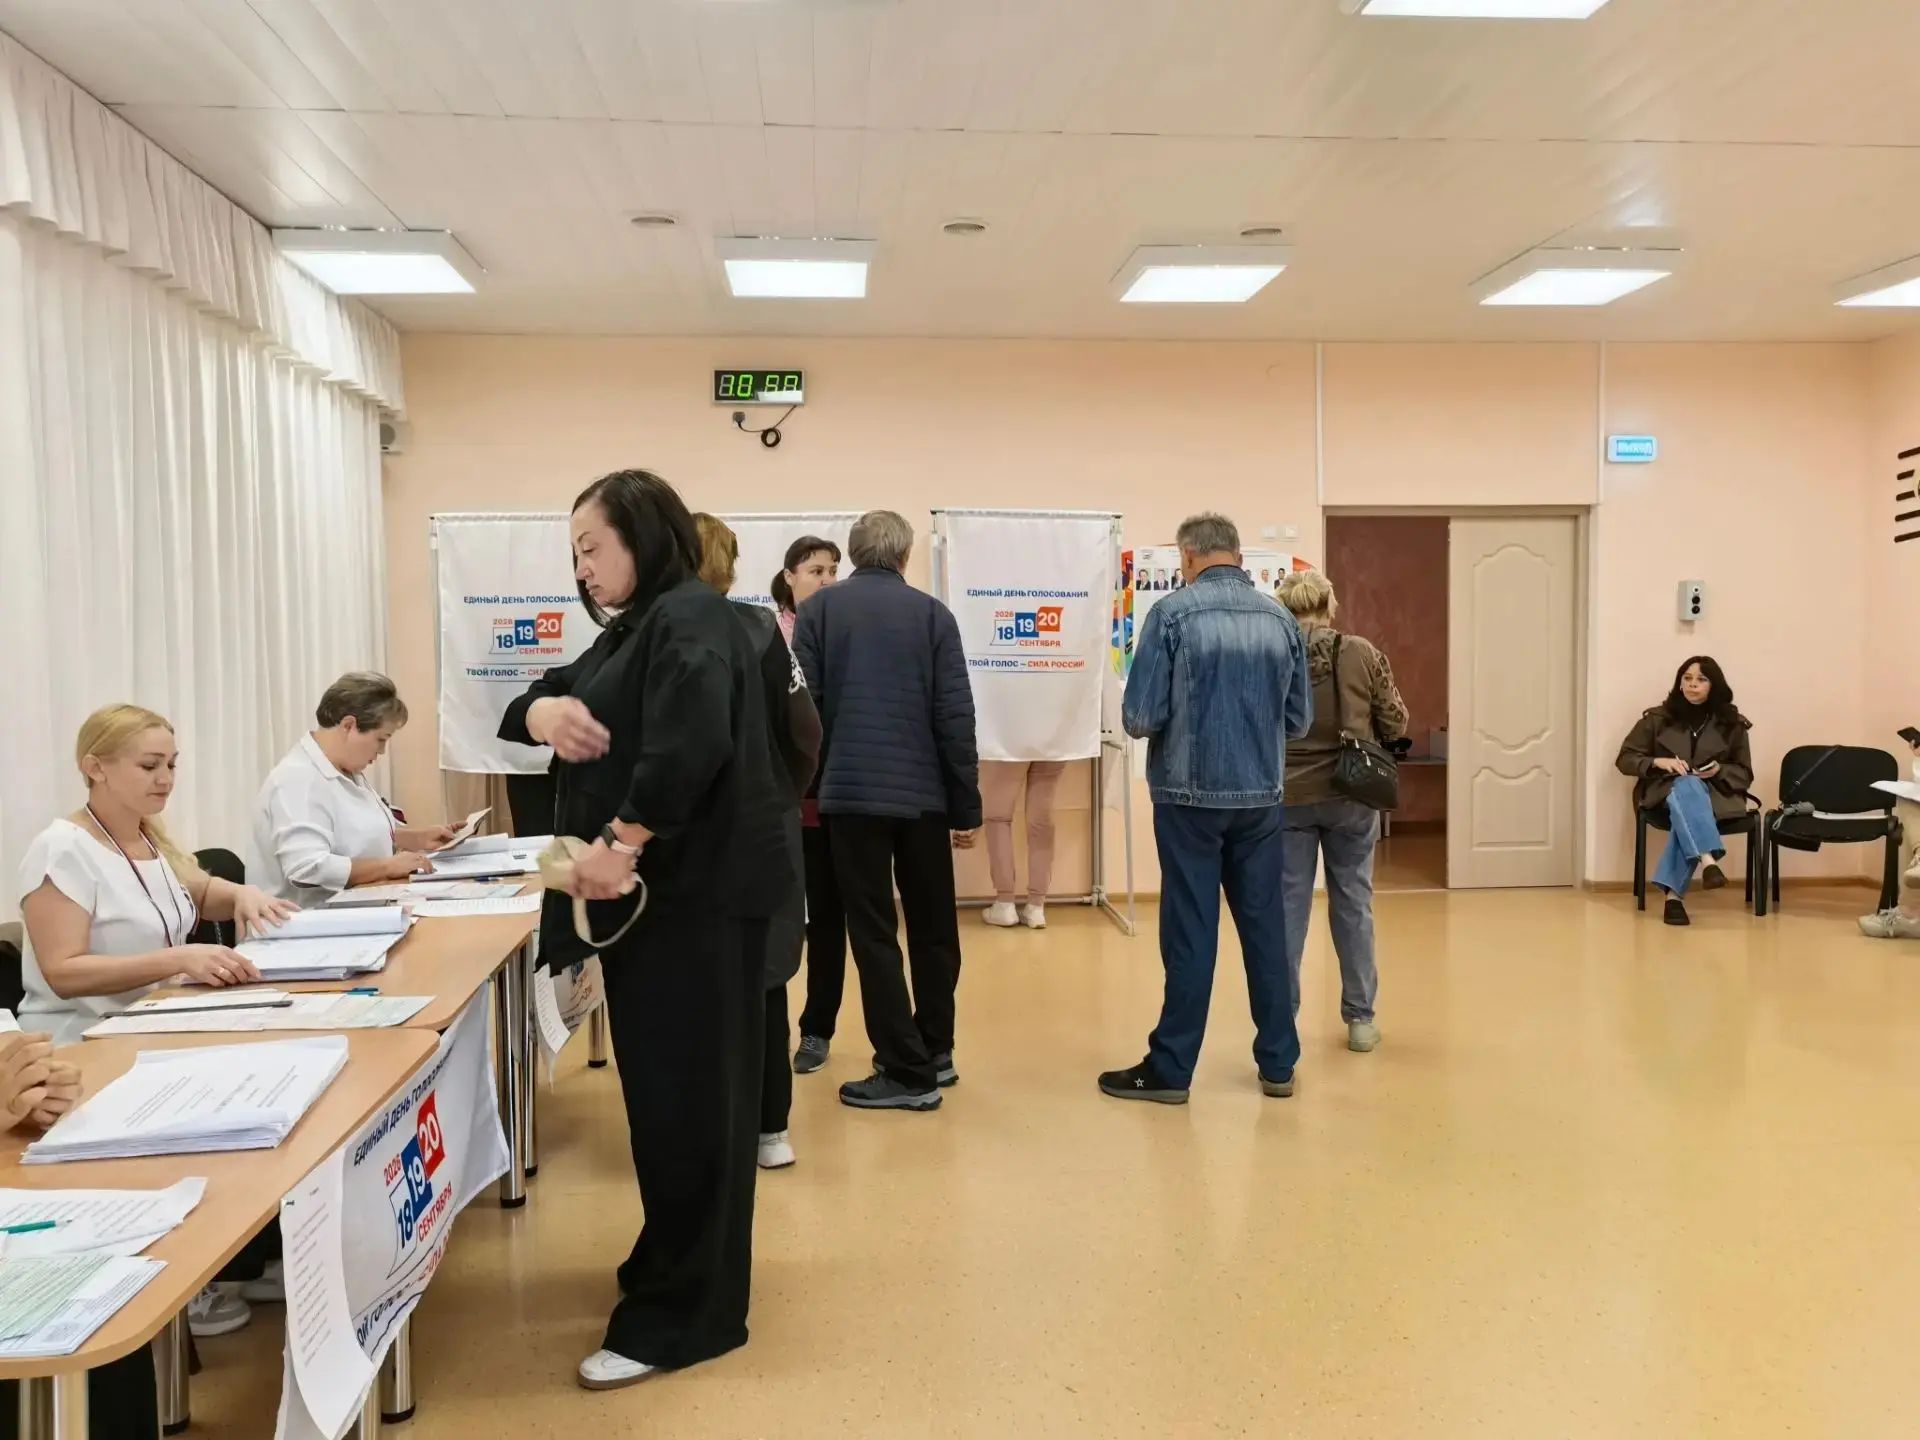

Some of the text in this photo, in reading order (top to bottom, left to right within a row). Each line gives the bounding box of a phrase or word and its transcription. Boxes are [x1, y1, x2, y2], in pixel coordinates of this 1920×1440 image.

[464, 595, 500, 604] ЕДИНЫЙ
[502, 595, 525, 604] ДЕНЬ
[967, 588, 1089, 598] ЕДИНЫЙ ДЕНЬ ГОЛОСОВАНИЯ
[496, 618, 559, 649] 18 19 20
[997, 612, 1058, 640] 18 19 20
[519, 647, 563, 655] СЕНТЯБРЯ
[968, 658, 989, 667] ТВОЙ
[1027, 660, 1050, 668] СИЛА
[466, 667, 489, 676] ТВОЙ
[490, 668, 519, 676] ГОЛОС
[527, 668, 545, 676] СИЛ
[353, 1112, 390, 1167] ЕДИНЫЙ
[389, 1096, 411, 1132] ДЕНЬ
[383, 1153, 402, 1187] 2026
[397, 1112, 440, 1249] 18 19 20
[417, 1181, 452, 1243] СЕНТЯБРЯ
